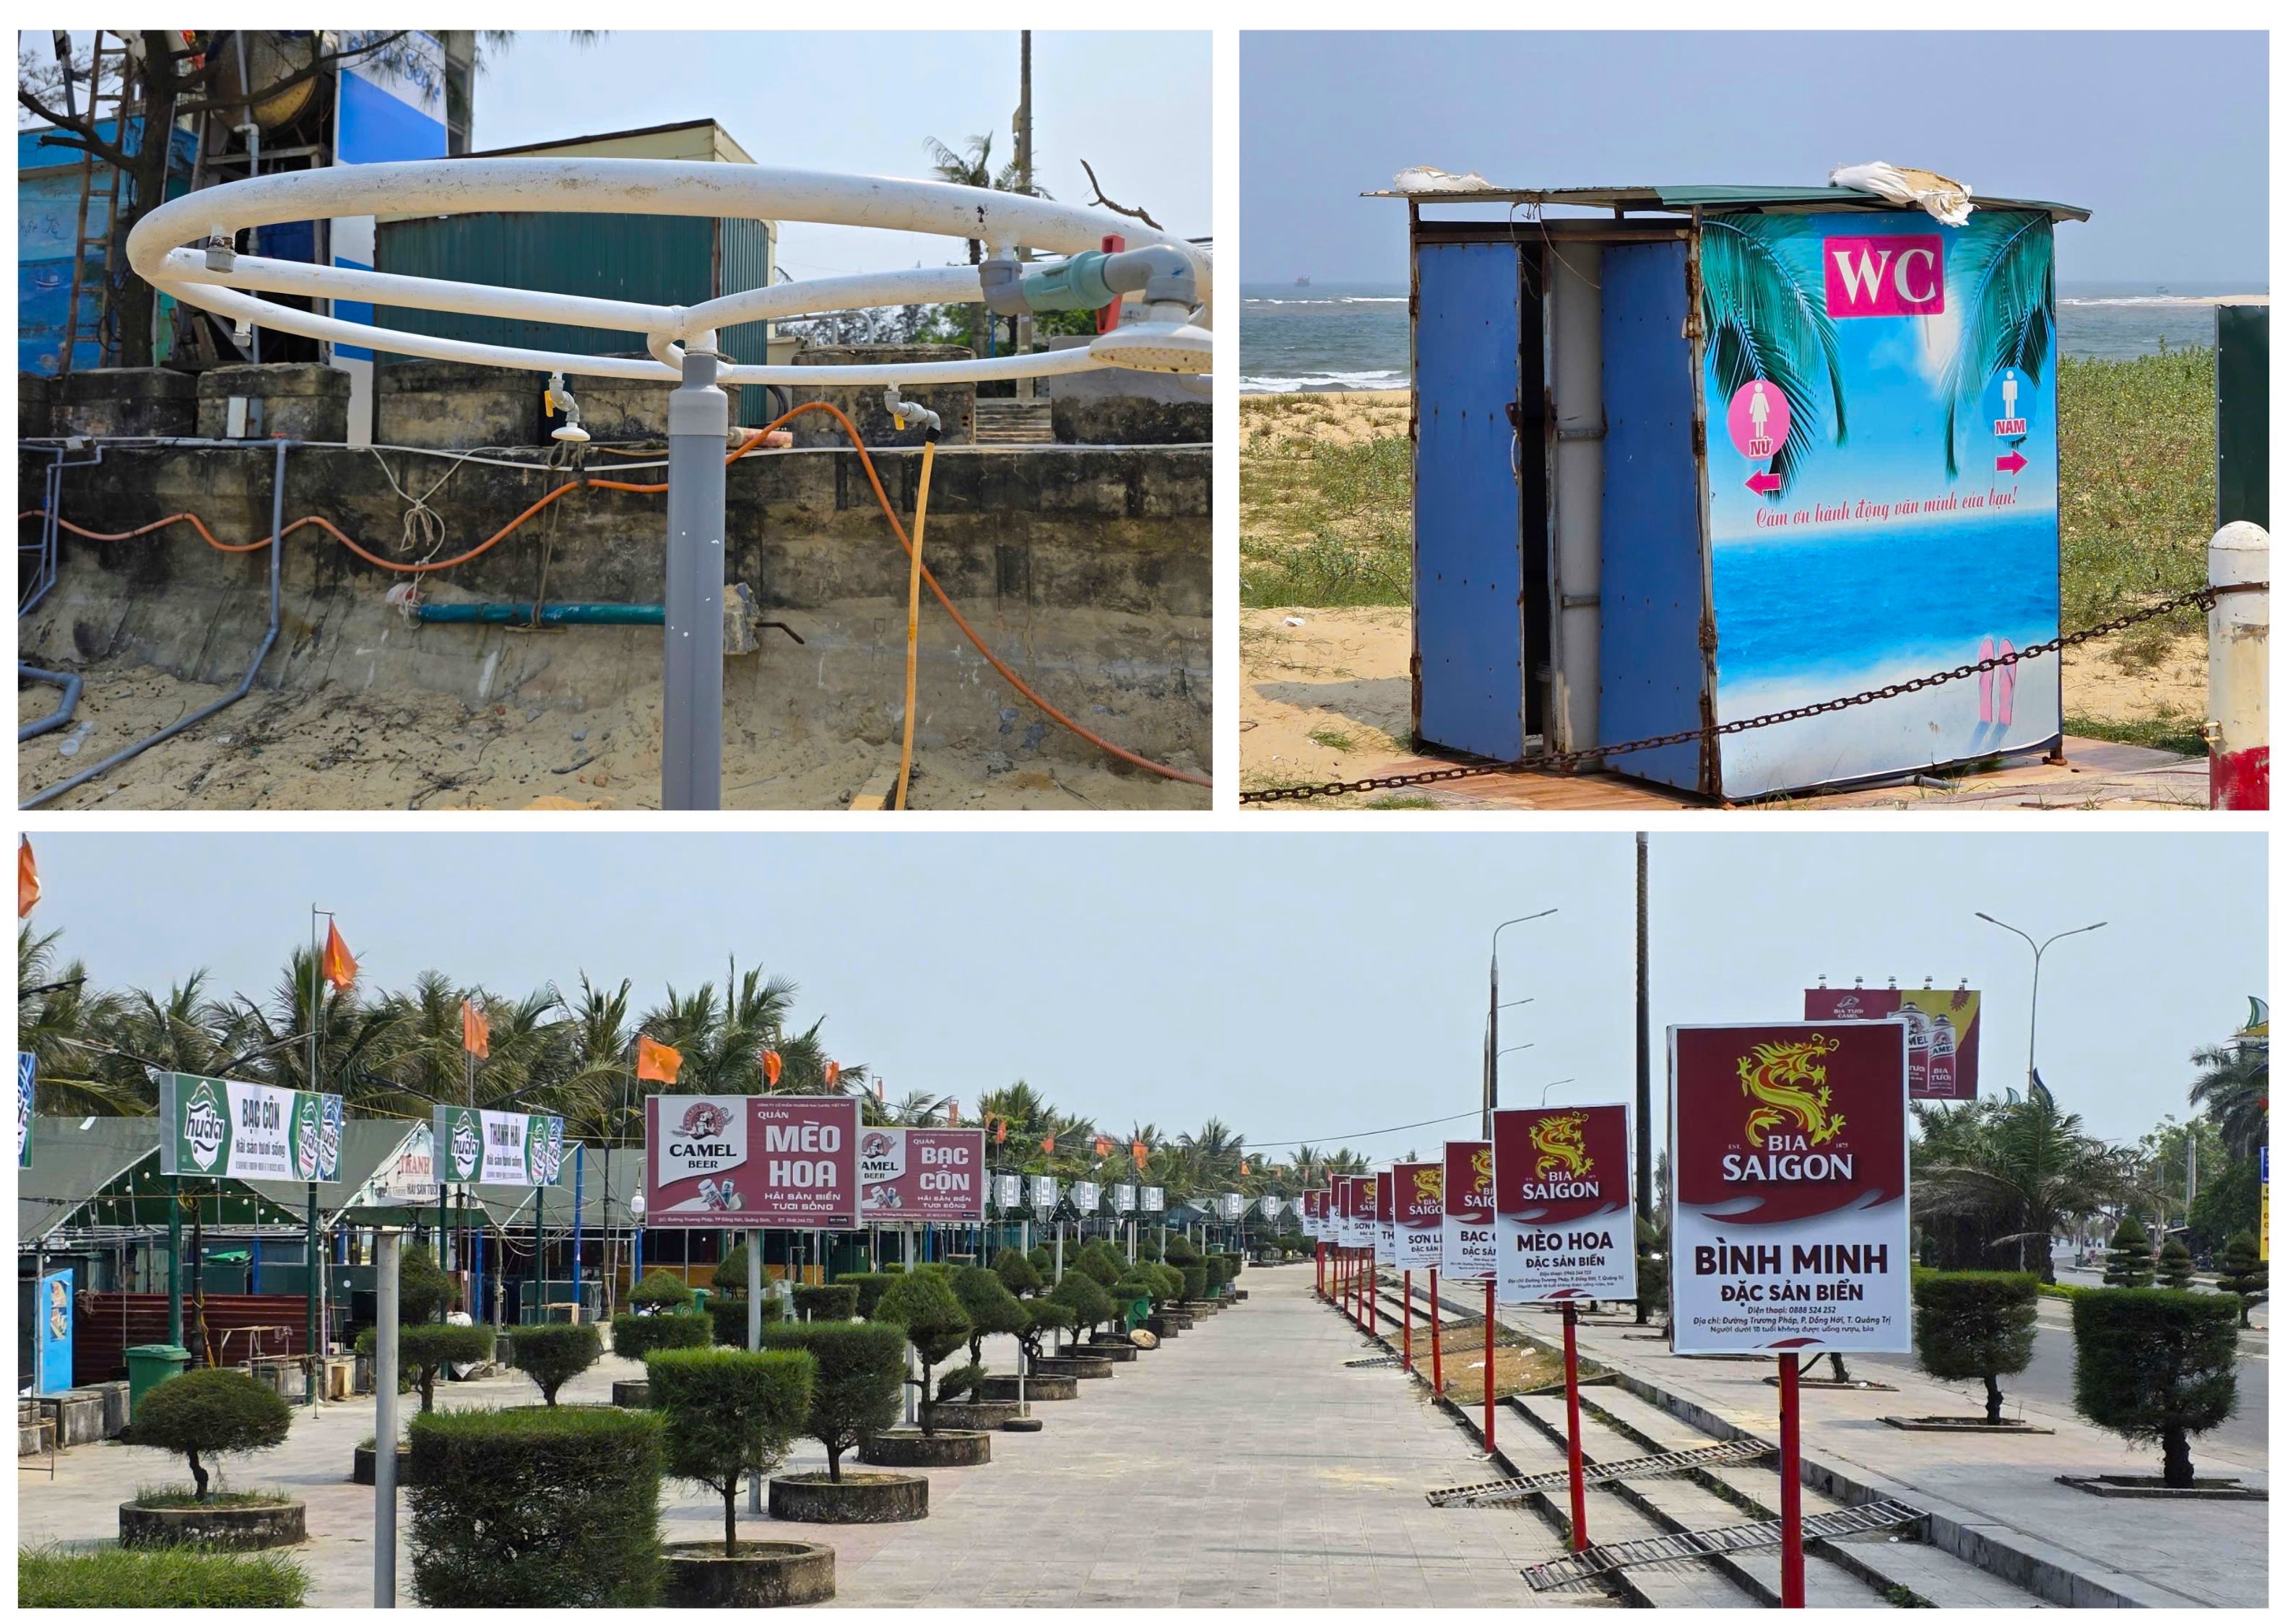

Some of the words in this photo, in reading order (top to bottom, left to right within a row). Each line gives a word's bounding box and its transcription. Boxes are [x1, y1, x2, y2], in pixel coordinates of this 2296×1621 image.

[1832, 248, 1936, 304] WC
[1996, 420, 2025, 434] NAM
[1750, 437, 1772, 456] NỮ
[1756, 507, 1788, 528] Cảm
[1793, 510, 1810, 524] ơn
[1815, 501, 1850, 523] hành
[1855, 499, 1889, 521] động
[1894, 500, 1919, 515] văn
[1924, 491, 1957, 512] minh
[1988, 486, 2017, 510] bạn!
[1909, 1035, 1928, 1046] MEL
[242, 1098, 260, 1134] BẠC
[263, 1095, 280, 1136] CỘN
[758, 1110, 789, 1119] QUÁN
[186, 1112, 223, 1140] huda
[766, 1120, 841, 1152] MÈO
[1768, 1135, 1807, 1151] BIA
[670, 1144, 737, 1157] CAMEL
[921, 1147, 969, 1168] BẠC
[769, 1160, 837, 1188] HOA
[862, 1161, 898, 1170] AMEL
[1723, 1154, 1853, 1181] SAIGON
[919, 1170, 969, 1194] CỘN
[1548, 1171, 1572, 1182] BIA
[765, 1191, 784, 1200] HẢI
[787, 1191, 812, 1200] SẢN
[1522, 1181, 1599, 1200] SAIGON
[1409, 1204, 1443, 1214] SAIGO
[1464, 1195, 1495, 1207] SAIG
[1408, 1233, 1431, 1244] SƠN
[1460, 1230, 1489, 1246] BẠC
[1517, 1229, 1562, 1252] MÈO
[1568, 1231, 1613, 1250] HOA
[1463, 1246, 1481, 1258] ĐẶC
[1695, 1237, 1781, 1275] BÌNH
[1793, 1244, 1887, 1274] MINH
[1526, 1256, 1550, 1271] ĐẶC
[1553, 1254, 1576, 1267] SẢN
[1579, 1253, 1605, 1266] BIỂN
[1720, 1280, 1764, 1307] ĐẶC
[1769, 1279, 1810, 1301] SẢN
[1816, 1279, 1863, 1301] BIỂN
[1750, 1316, 1777, 1326] Trương
[1778, 1316, 1799, 1326] Pháp,
[1855, 1316, 1880, 1325] Quảng
[1881, 1316, 1892, 1326] Trị
